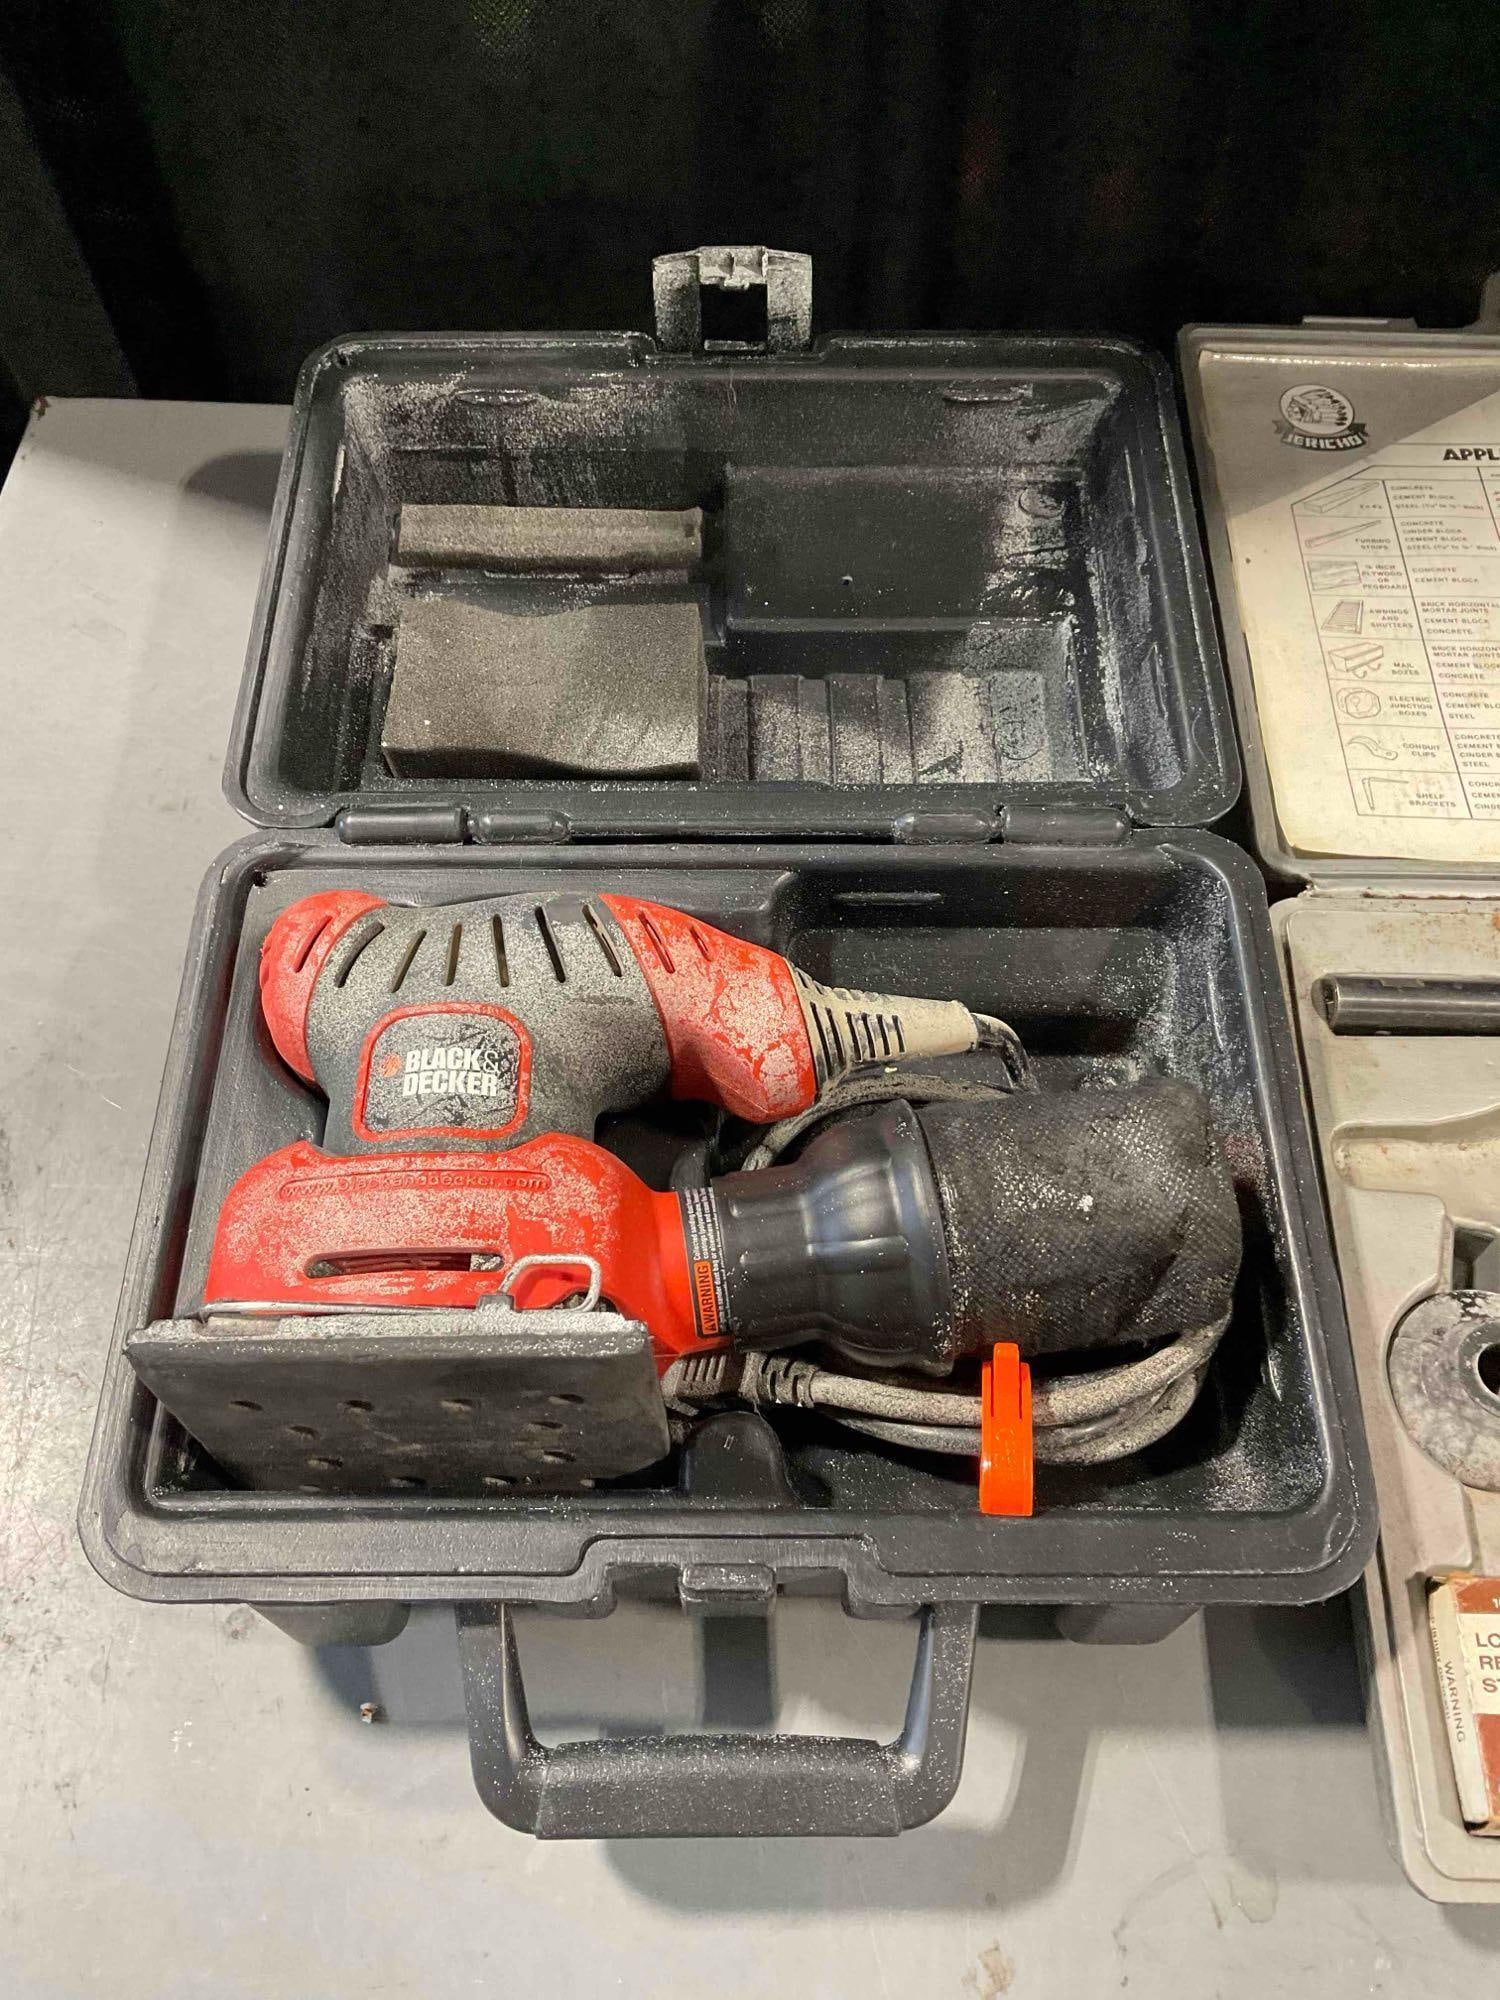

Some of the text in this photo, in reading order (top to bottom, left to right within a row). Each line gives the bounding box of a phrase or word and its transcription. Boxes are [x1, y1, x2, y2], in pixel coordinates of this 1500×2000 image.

[1282, 433, 1363, 450] JERICHO
[1402, 742, 1441, 751] CONDUIT
[1408, 799, 1457, 808] BRACKETS
[404, 1046, 482, 1073] BLACK
[402, 1070, 498, 1096] DECKER
[284, 1172, 549, 1196] www.blackanddecker.com
[698, 1265, 716, 1324] WARNING
[1444, 1660, 1466, 1742] WARNING
